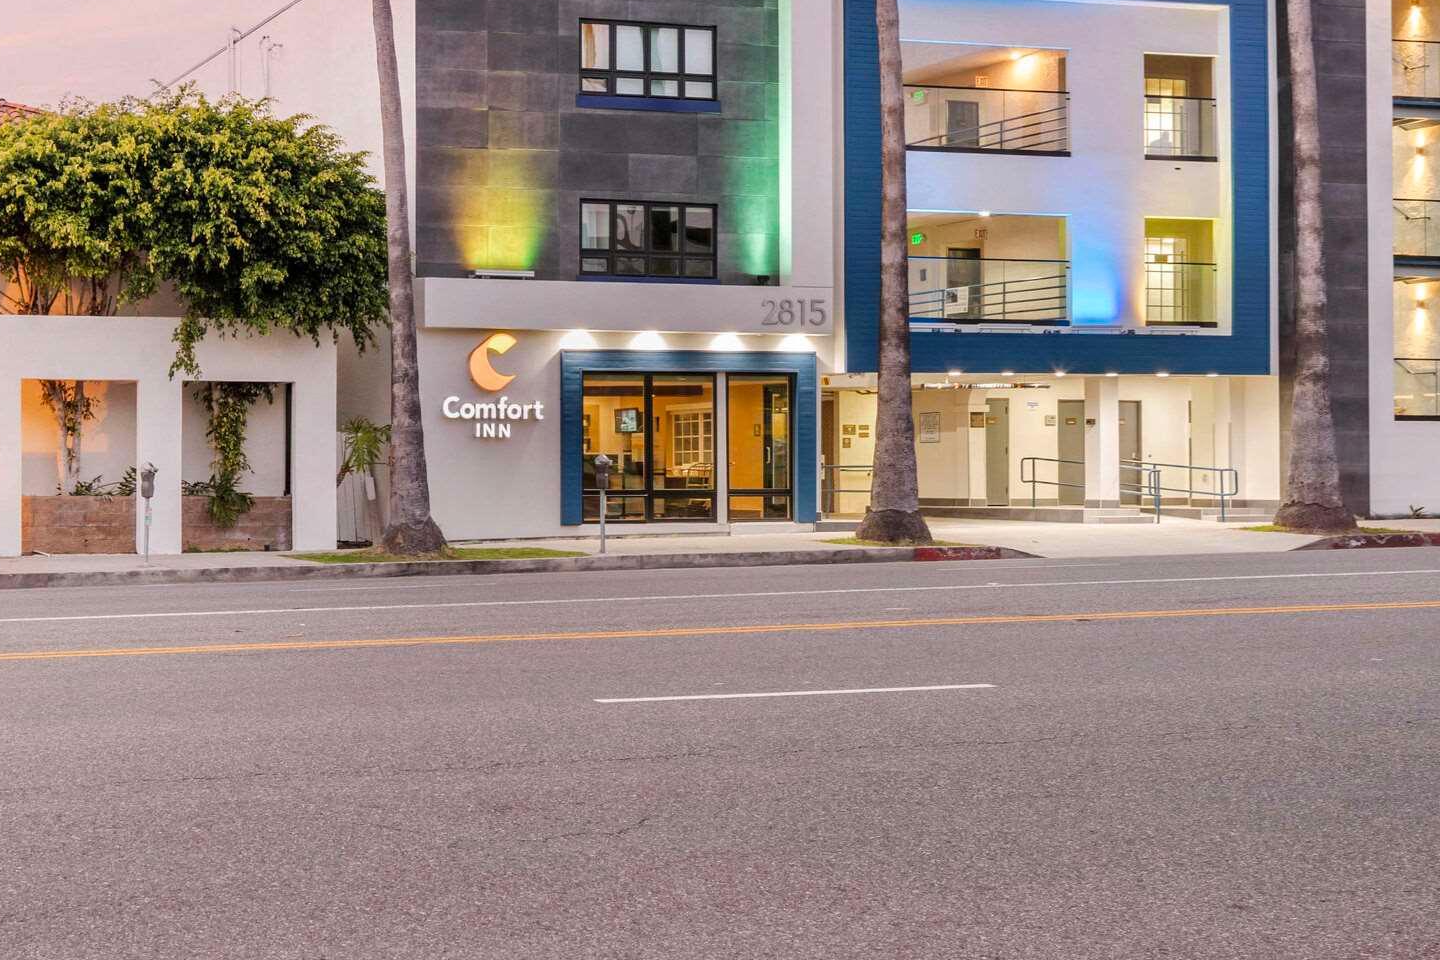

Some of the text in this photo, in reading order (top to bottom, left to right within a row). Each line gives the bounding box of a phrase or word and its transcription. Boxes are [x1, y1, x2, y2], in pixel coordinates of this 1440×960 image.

[761, 299, 827, 326] 2815
[442, 395, 544, 420] Comfort
[475, 422, 511, 438] INN
